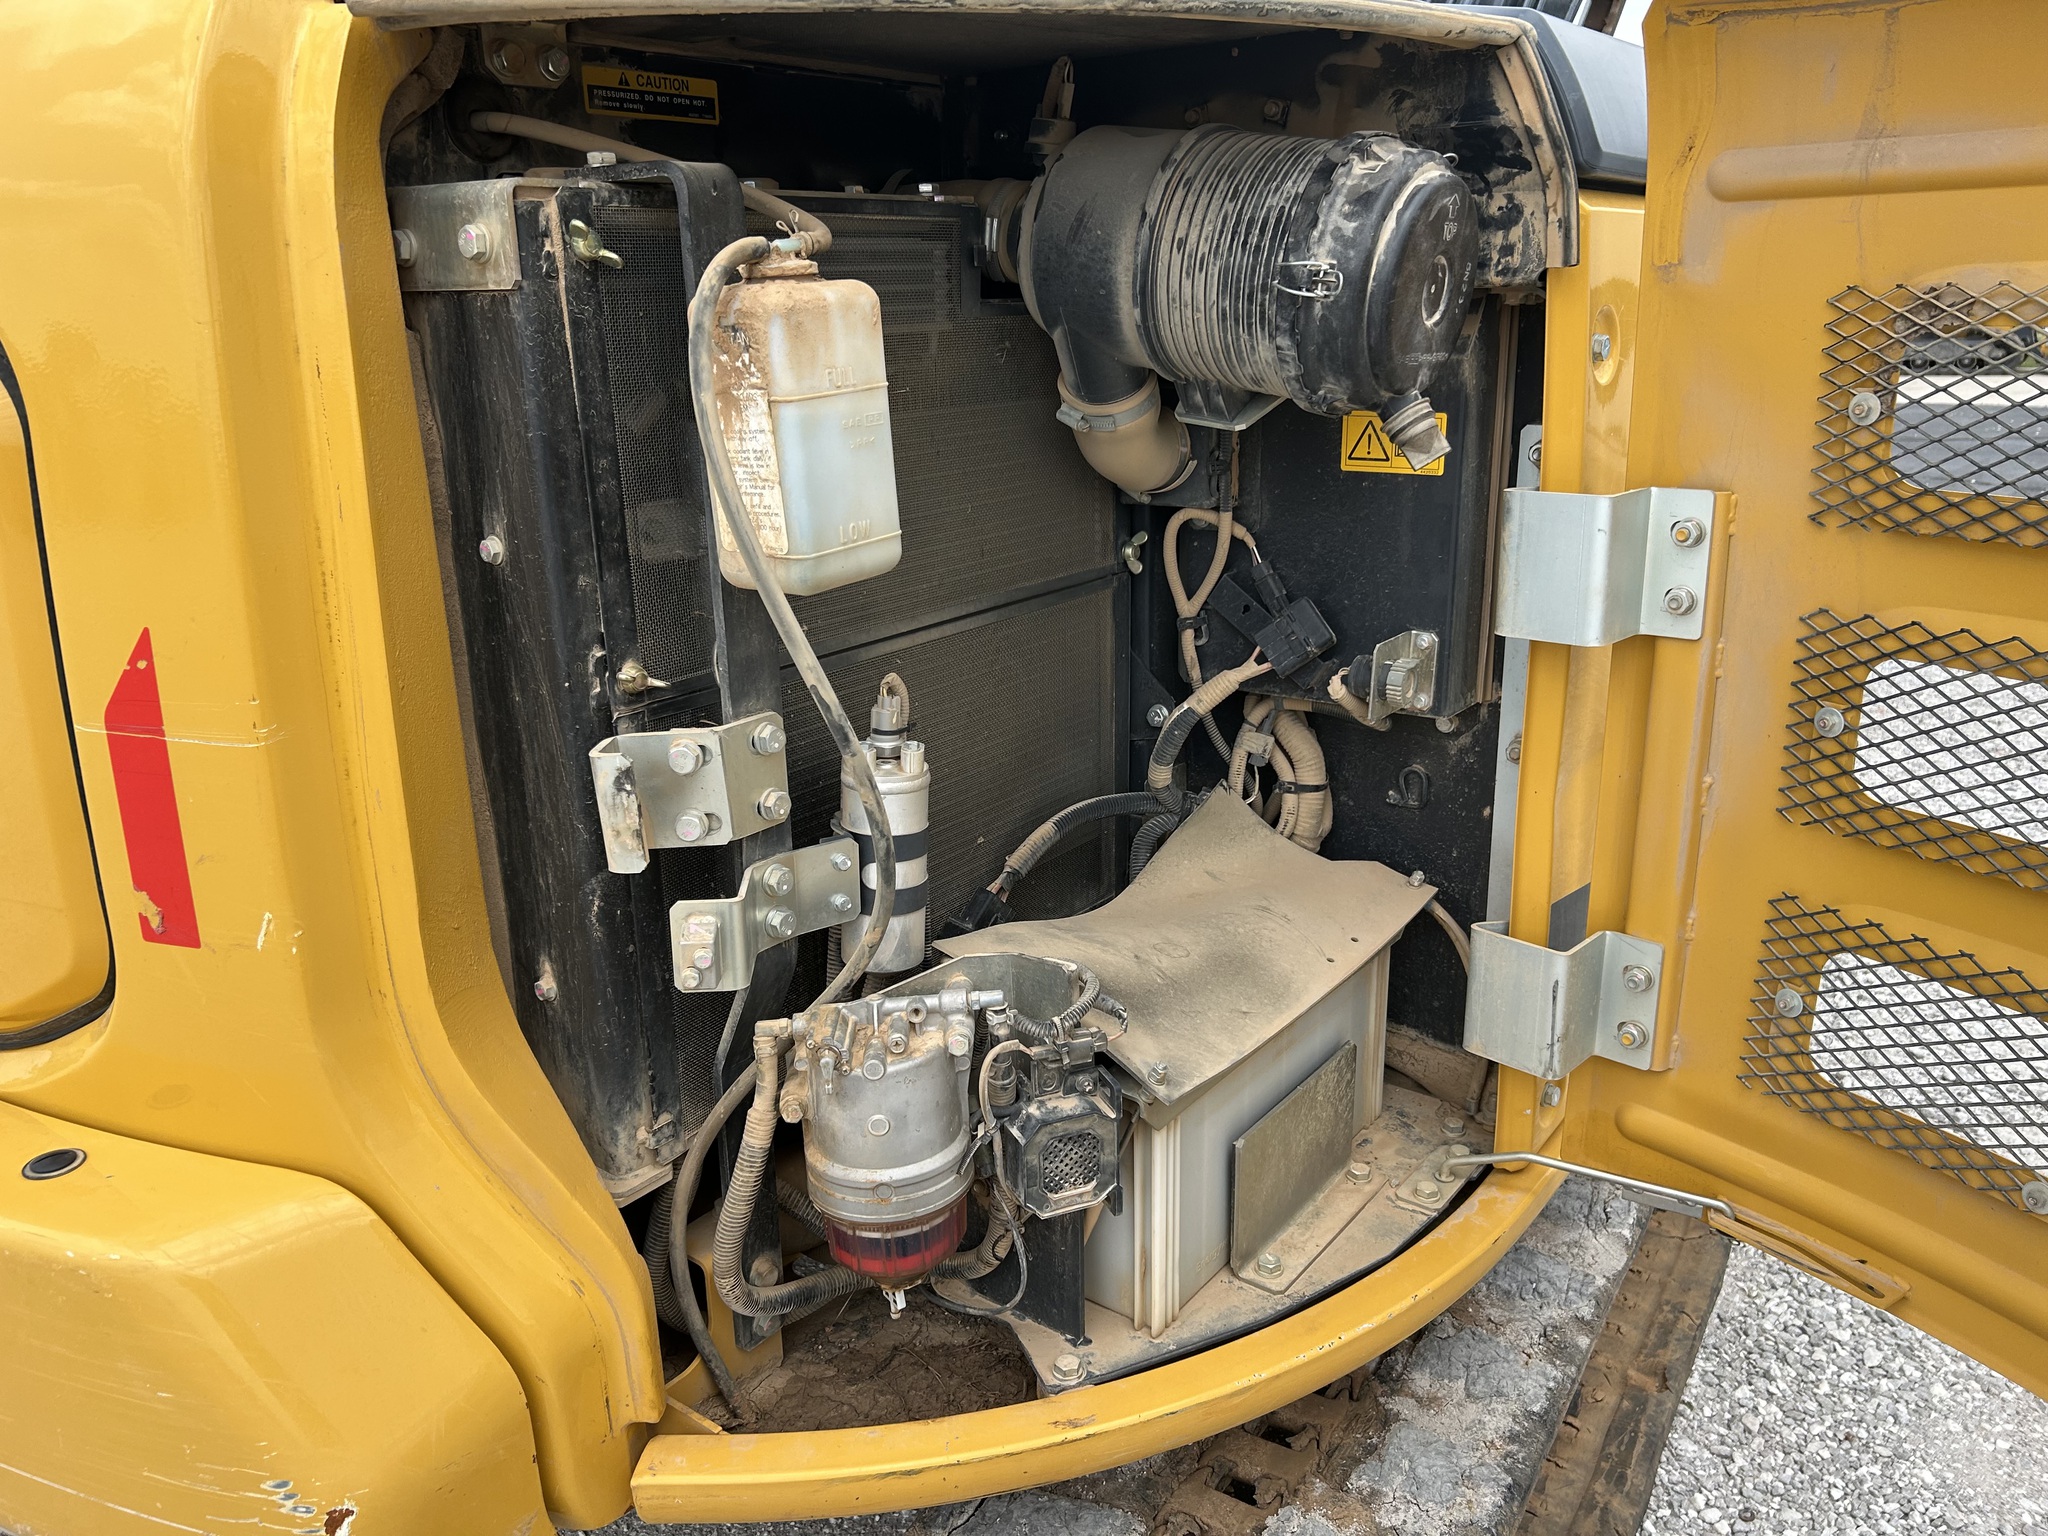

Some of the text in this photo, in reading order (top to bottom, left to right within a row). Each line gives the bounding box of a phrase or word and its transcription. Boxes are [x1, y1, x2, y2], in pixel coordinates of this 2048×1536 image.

[636, 74, 690, 92] CAUTION
[593, 88, 642, 100] PRESSURIZED.
[673, 97, 690, 105] OPEN
[594, 99, 620, 108] Remove
[1443, 222, 1458, 241] TOP
[824, 366, 857, 388] FULL
[839, 519, 871, 545] LOW
